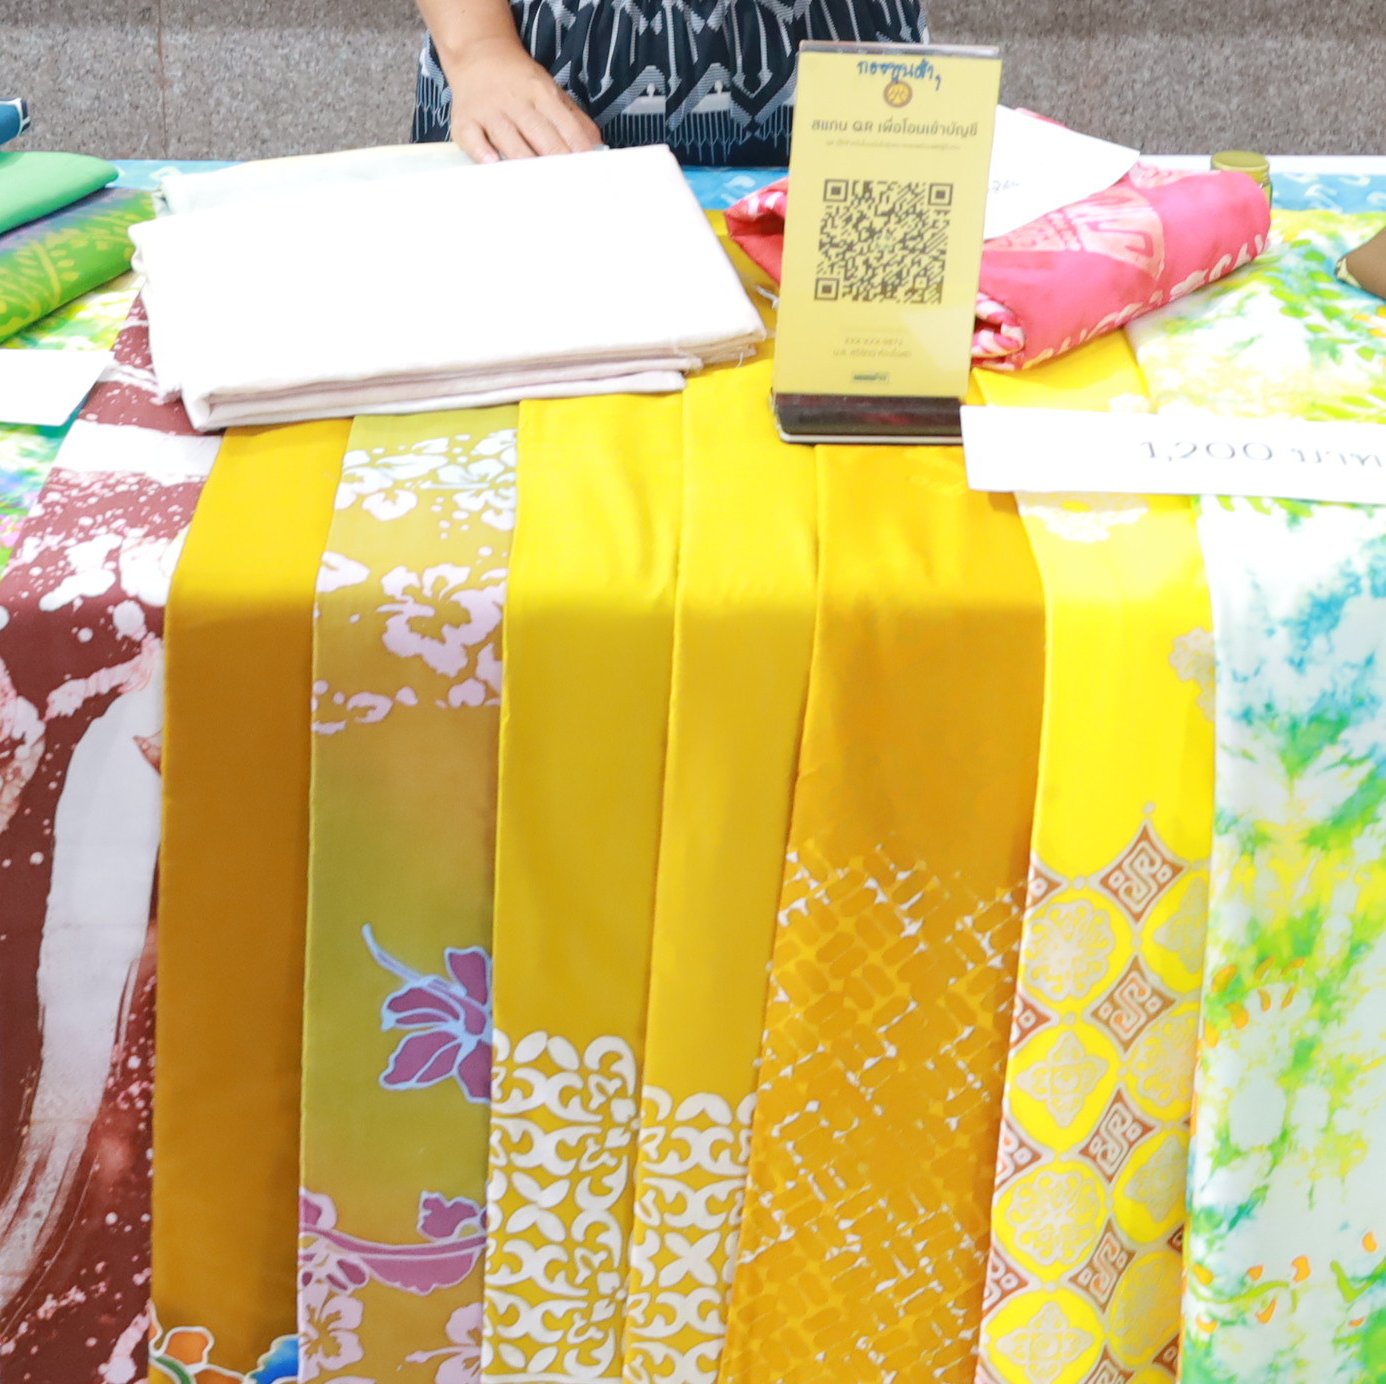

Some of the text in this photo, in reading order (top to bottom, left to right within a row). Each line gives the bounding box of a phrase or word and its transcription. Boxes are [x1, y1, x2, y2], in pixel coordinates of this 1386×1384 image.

[811, 118, 848, 132] สแกน
[852, 119, 874, 133] QR
[1140, 441, 1274, 462] 1,200
